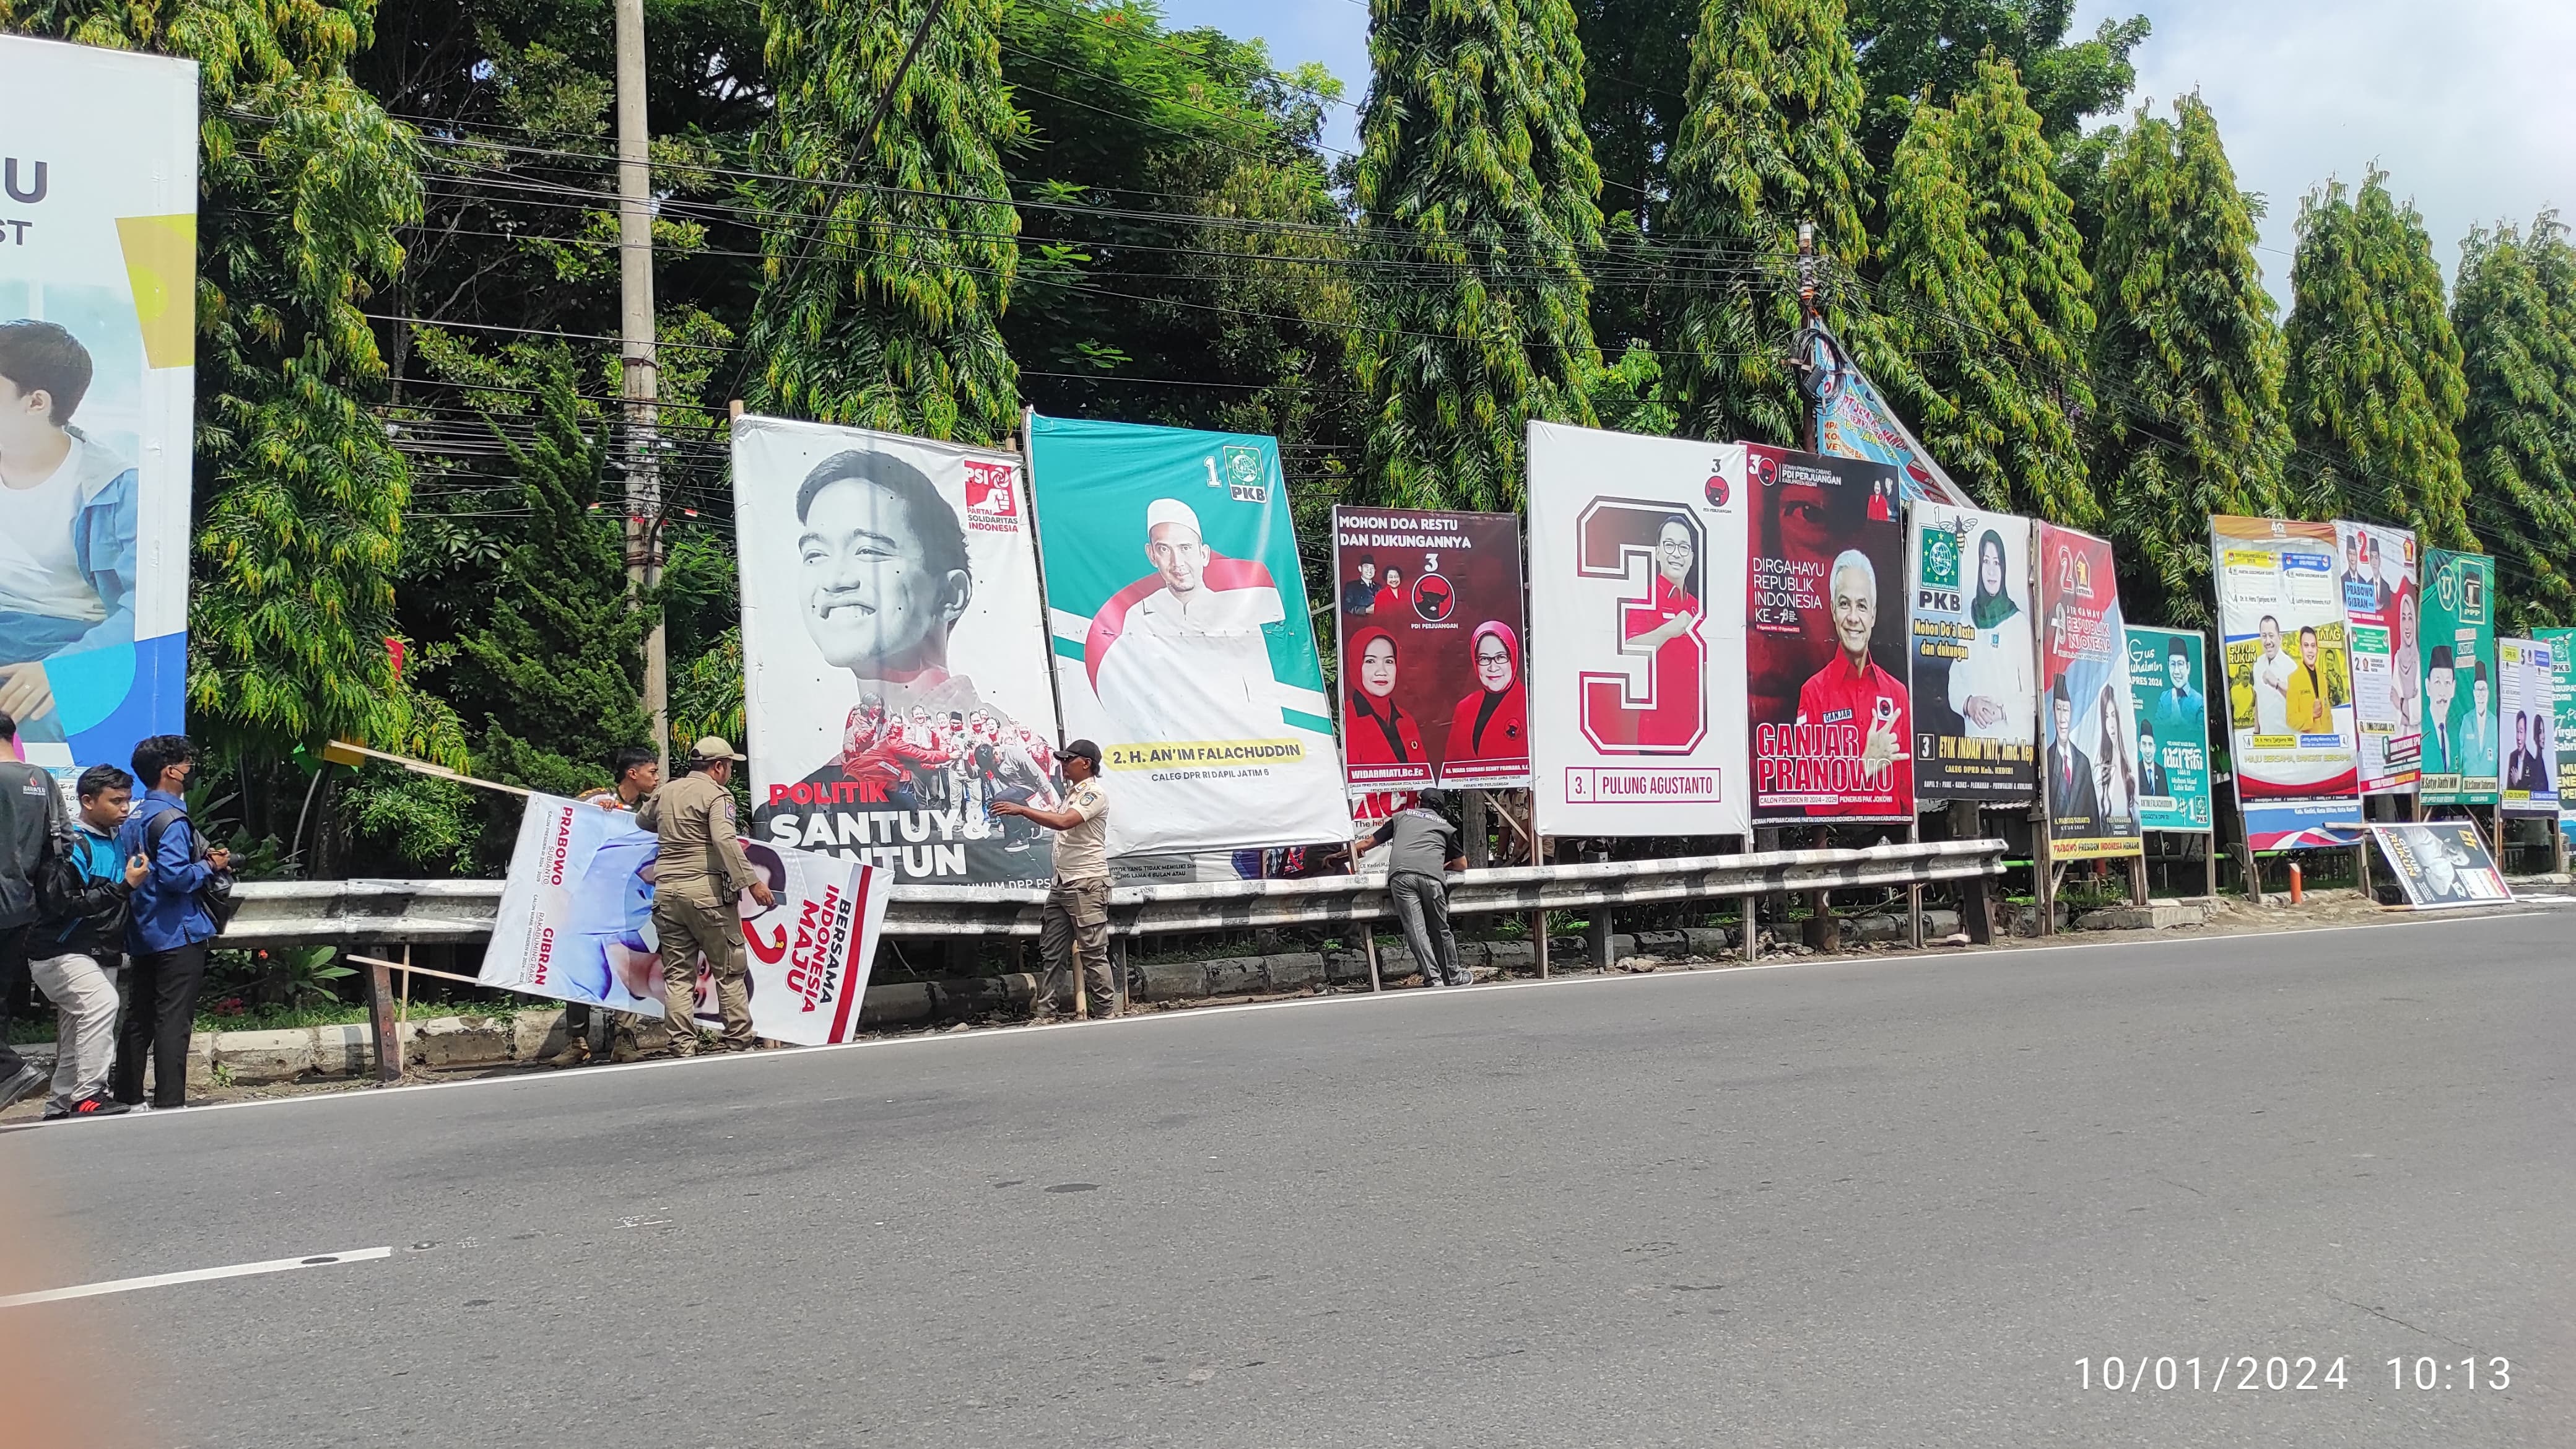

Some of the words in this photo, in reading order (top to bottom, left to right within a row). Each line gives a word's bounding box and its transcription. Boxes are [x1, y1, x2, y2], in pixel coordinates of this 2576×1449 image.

[1203, 456, 1222, 488] 1
[1711, 458, 1721, 473] 3
[1748, 454, 1762, 474] 3
[965, 466, 989, 485] PSI
[1782, 469, 1795, 479] PDI
[1795, 471, 1842, 485] PERJUANGAN
[1231, 485, 1266, 502] PKB
[967, 507, 992, 515] PARTAI
[968, 515, 1018, 524] SOLIDARITAS
[968, 522, 1019, 533] INDONESIA
[1339, 516, 1388, 529] MOHON
[1390, 518, 1419, 530] DOA
[1421, 519, 1458, 531] RESTU
[1339, 533, 1369, 547] DAN
[1372, 534, 1472, 549] DUKUNGANNYA
[2357, 530, 2369, 564] 2
[1424, 553, 1438, 572] 3
[1753, 557, 1824, 577] DIRGAHAYU
[2059, 545, 2074, 593] 2
[1754, 574, 1814, 593] REPUBLIK
[2346, 584, 2373, 598] PRABOWO
[1754, 590, 1823, 609] INDONESIA
[1919, 591, 1960, 612] PKB
[2348, 596, 2369, 609] GIBRAN
[1755, 607, 1771, 623] KE
[1577, 495, 1707, 756] 3
[1914, 619, 1939, 637] Mohon
[1940, 620, 1957, 638] Do'a
[1957, 622, 1975, 640] Restu
[2317, 629, 2341, 642] TATAG
[1920, 639, 1935, 656] dan
[1936, 640, 1969, 662] dukungan
[2128, 638, 2155, 661] Gus
[2229, 644, 2256, 655] GUYUB
[2229, 653, 2257, 664] RUKUN
[2520, 648, 2525, 665] 5
[2130, 659, 2162, 673] uhaimin
[2147, 678, 2162, 687] 2024
[1824, 710, 1852, 722] GANJAR
[1756, 723, 1859, 759] GANJAR
[1921, 736, 1930, 757] 3
[1112, 751, 1126, 764] 2.
[1129, 750, 1146, 763] H.
[1150, 747, 1195, 762] AN'IM
[1198, 744, 1300, 760] FALACHUDDIN
[1939, 736, 1956, 759] ETIK
[1957, 736, 1982, 759] INDAH
[1982, 737, 2000, 765] YATI,
[2002, 738, 2020, 761] Amd.
[2021, 739, 2034, 766] Kep
[2162, 747, 2182, 768] Idul
[1151, 772, 1181, 781] CALEG
[1183, 771, 1201, 780] DPR
[1212, 770, 1235, 778] DAPIL
[1237, 769, 1262, 778] JATIM
[1757, 757, 1894, 793] PRANOWO
[1945, 765, 1962, 773] CALEG
[1963, 765, 1980, 774] DPRD
[1981, 766, 1993, 774] Kab.
[1995, 767, 2014, 775] KEDIRI
[769, 781, 890, 806] POLITIK
[1575, 776, 1586, 794] 3.
[1603, 776, 1647, 794] PULUNG
[1650, 776, 1713, 794] AGUSTANTO
[1760, 796, 1778, 804] CALON
[550, 806, 573, 886] PRABOWO
[2078, 842, 2099, 851] PRESIDEN
[2100, 842, 2122, 851] INDONESIA
[2388, 833, 2417, 877] RUKUN
[2398, 837, 2422, 873] GUYUB
[543, 845, 555, 885] SUBIANTO
[1008, 879, 1033, 890] DPP
[1036, 877, 1053, 889] PS
[530, 912, 545, 962] RAKABUMING
[787, 899, 820, 994] MAJU
[535, 928, 554, 986] GIBRAN
[802, 884, 840, 1013] INDONESIA
[820, 899, 852, 1003] BERSAMA
[528, 963, 536, 983] RAKA
